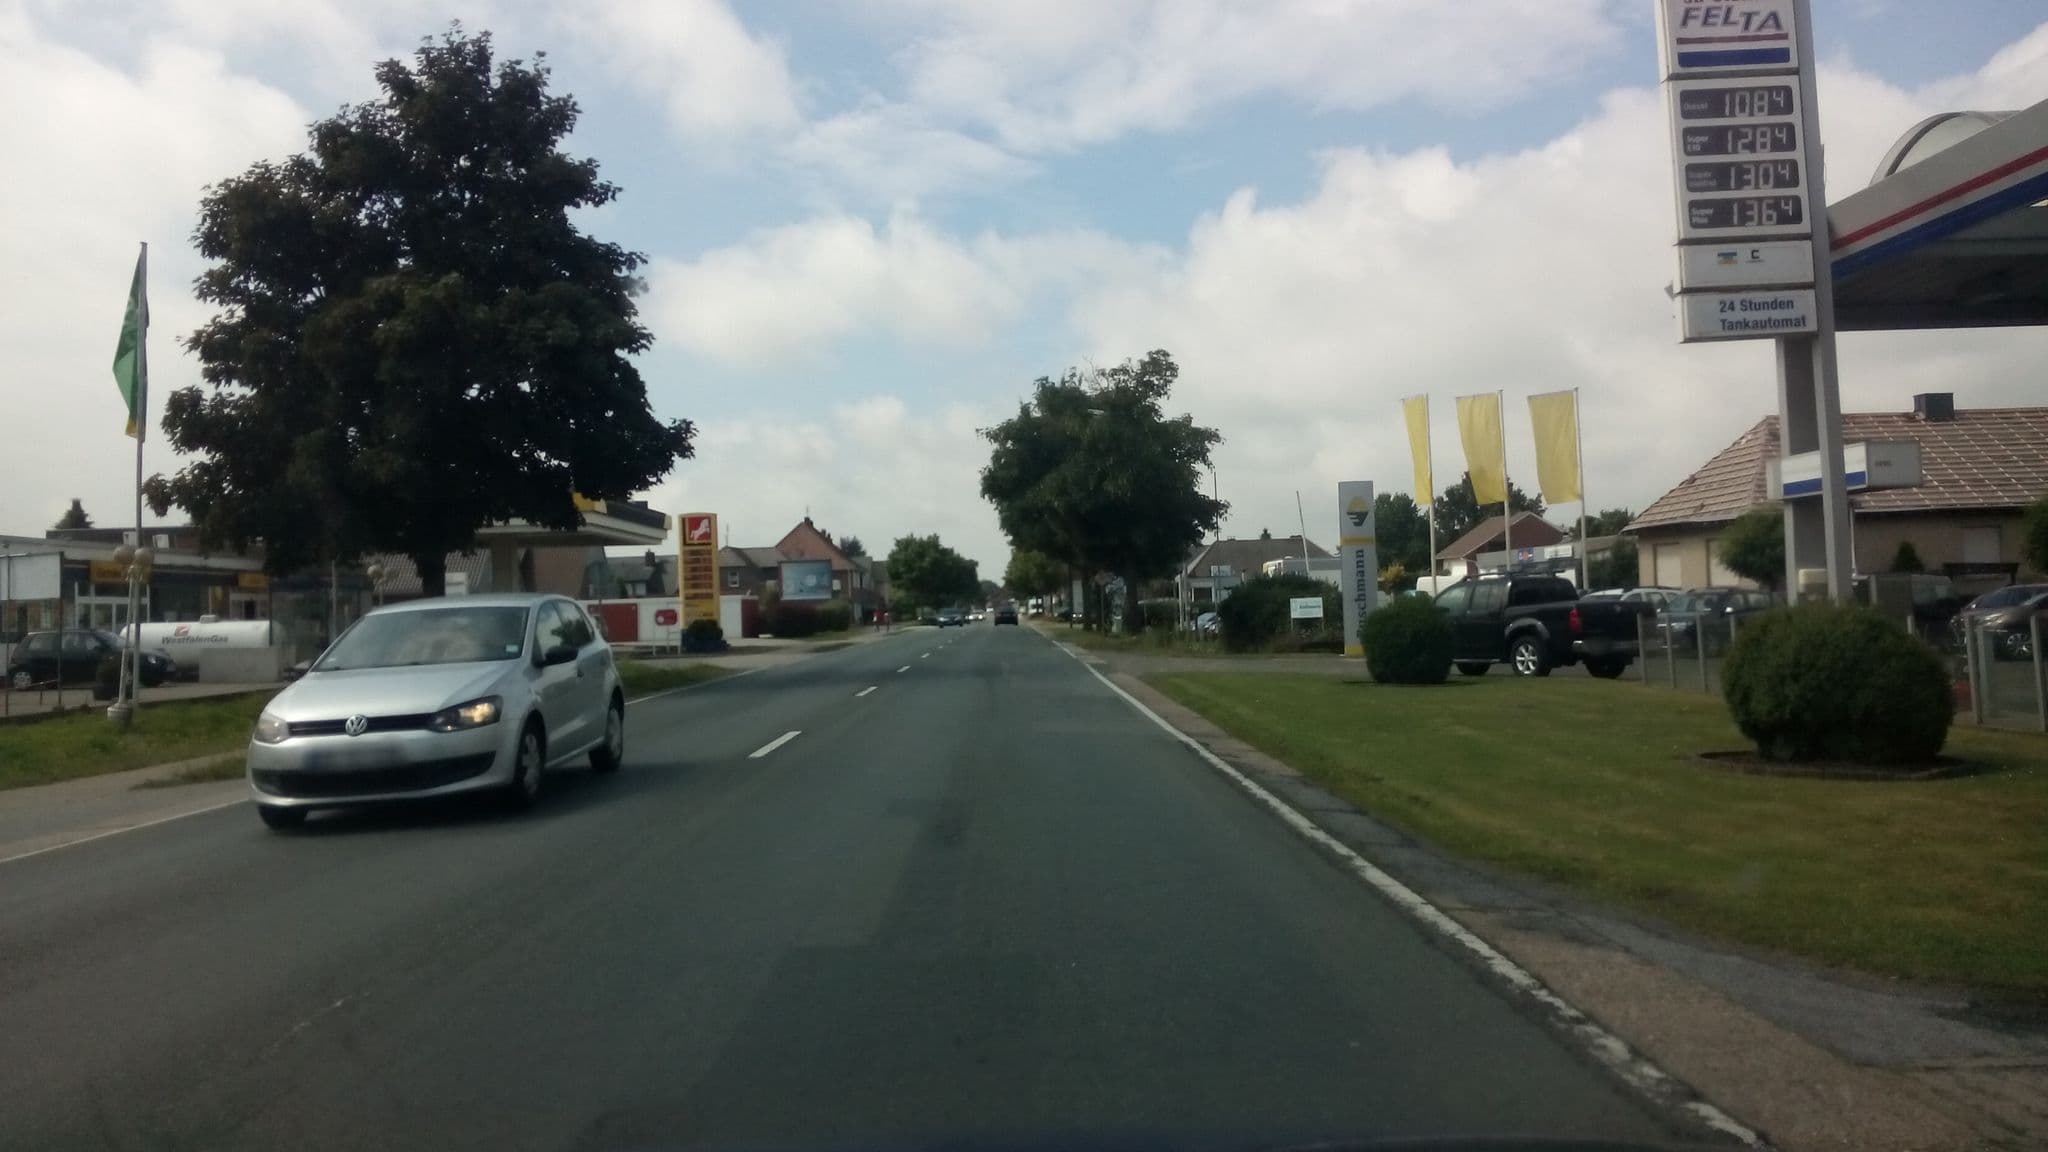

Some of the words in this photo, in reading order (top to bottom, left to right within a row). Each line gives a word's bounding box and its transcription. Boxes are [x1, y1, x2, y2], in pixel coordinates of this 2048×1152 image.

[1680, 4, 1783, 32] FELTA
[1719, 300, 1735, 313] 24
[1740, 299, 1794, 312] Stunden
[1720, 315, 1806, 330] Tankautomat
